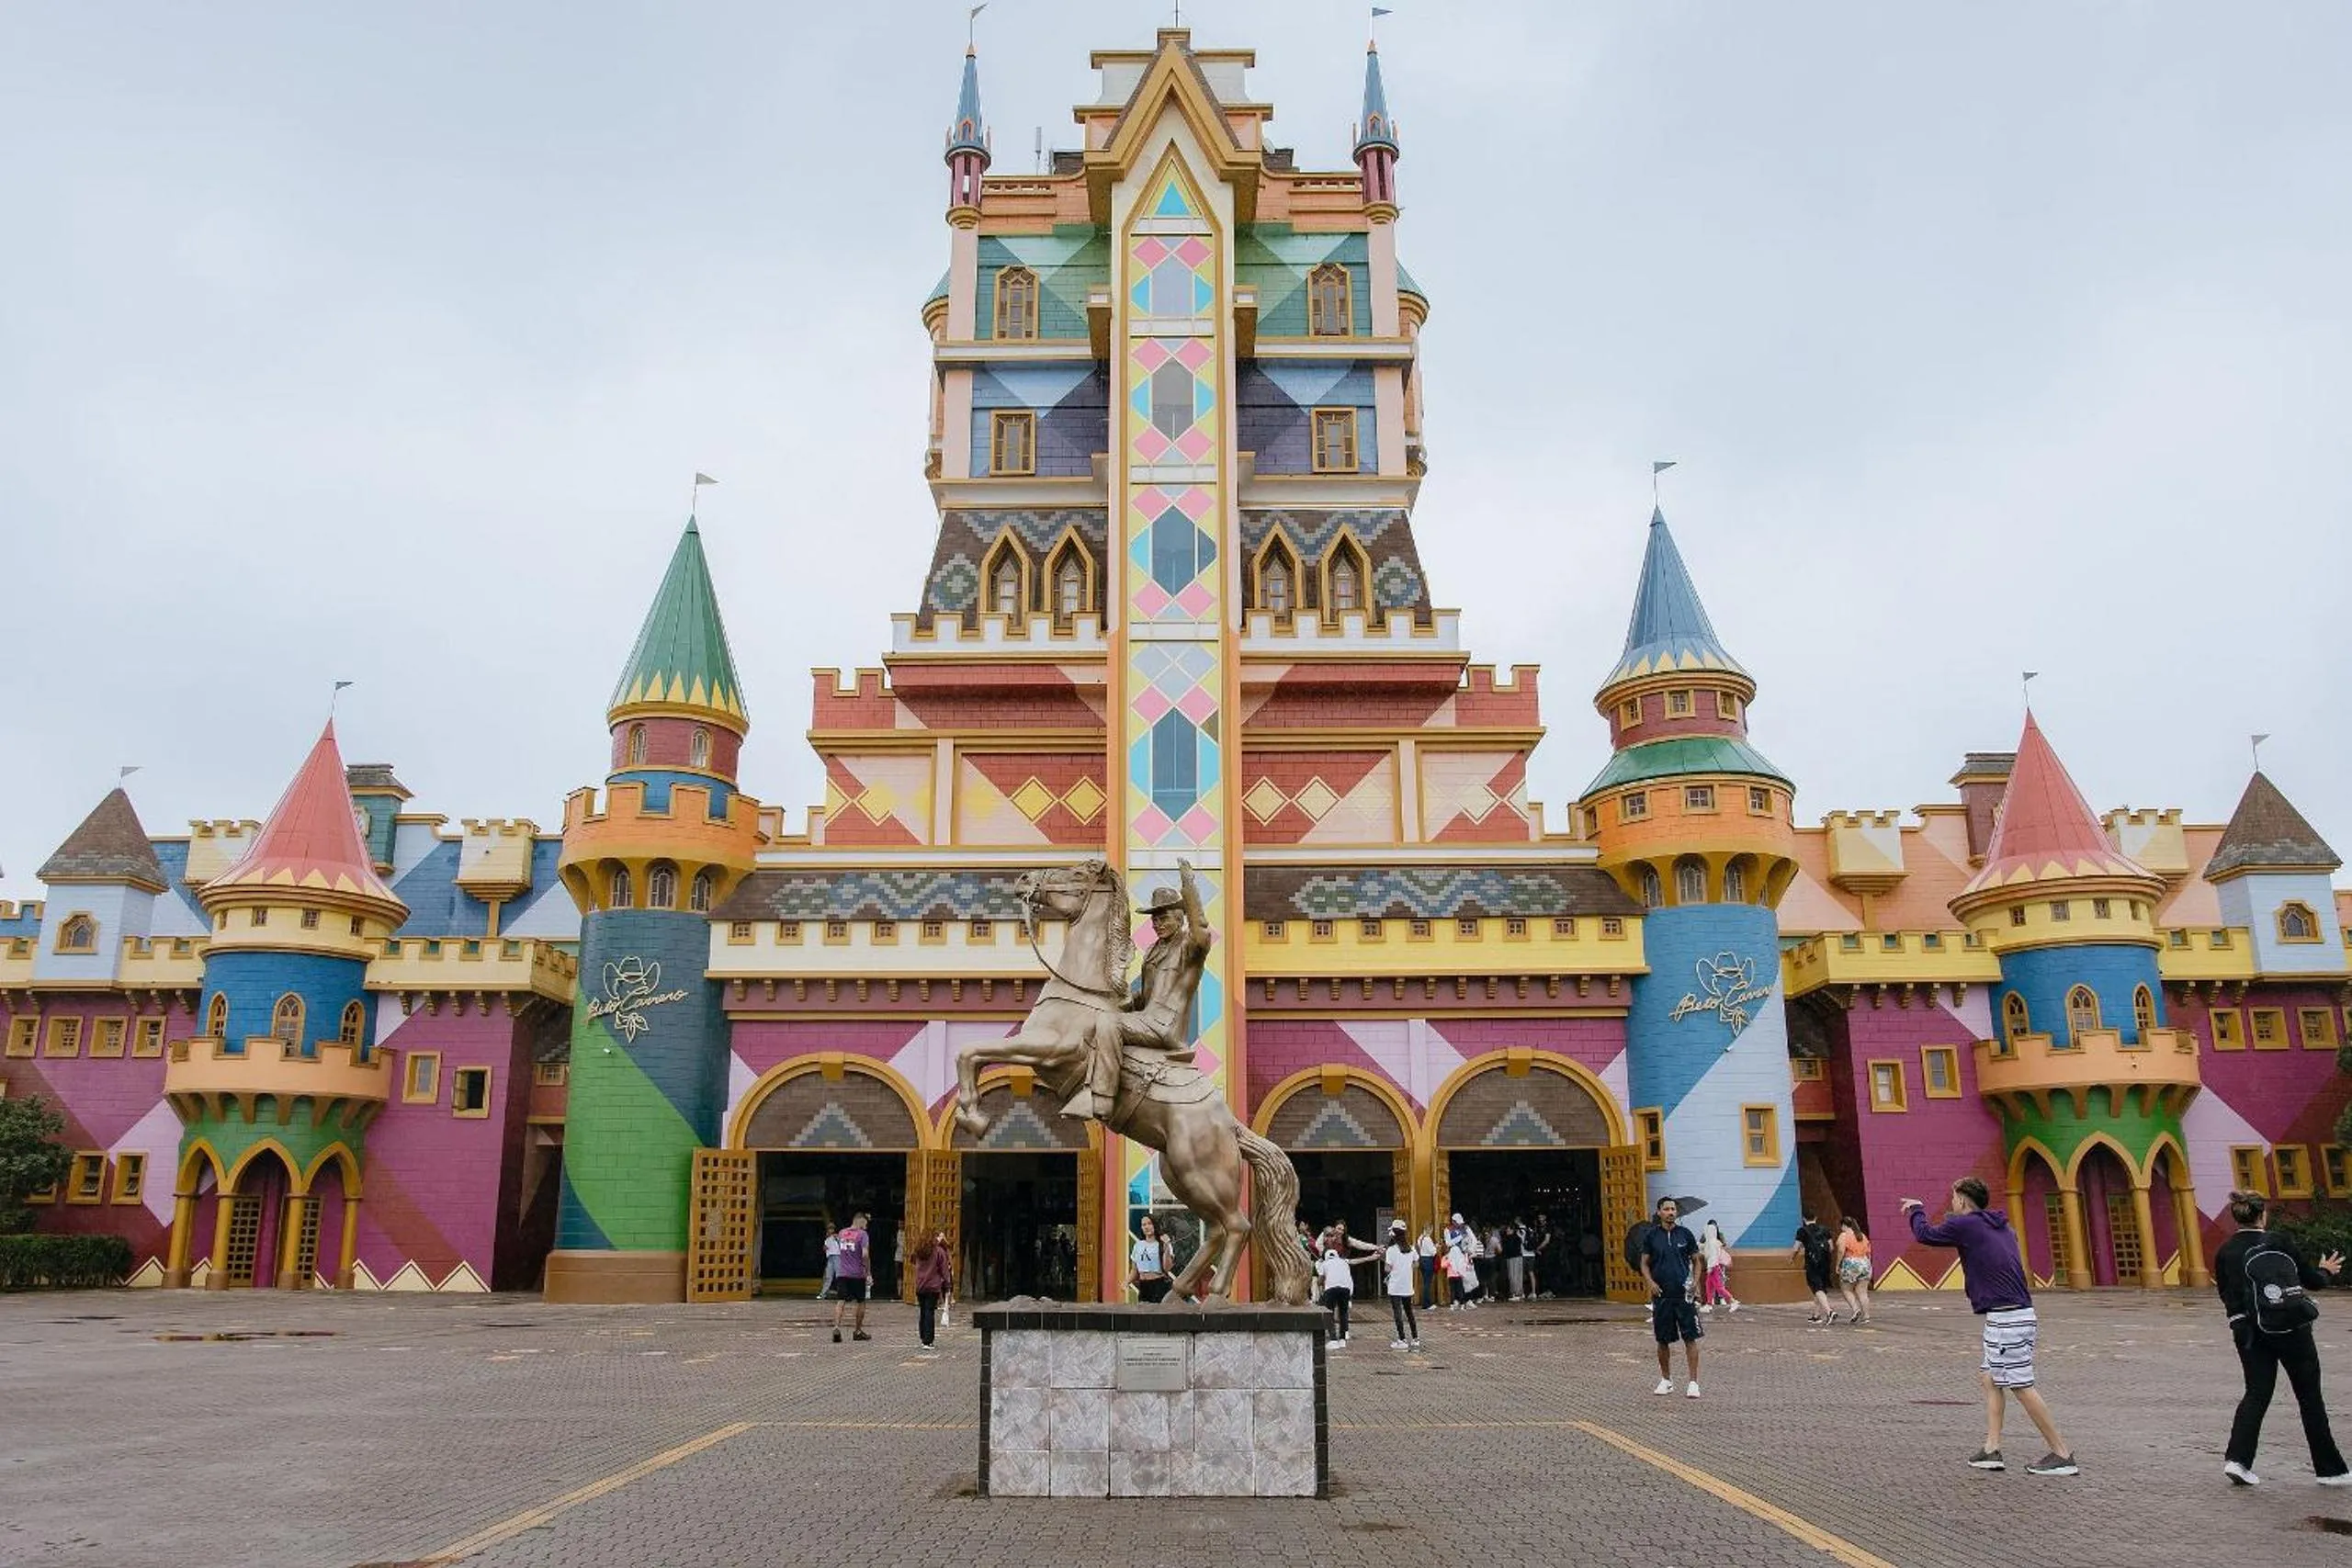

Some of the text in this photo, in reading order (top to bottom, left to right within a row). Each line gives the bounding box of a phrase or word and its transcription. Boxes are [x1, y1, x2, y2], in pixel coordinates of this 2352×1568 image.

[620, 986, 689, 1010] Carrero
[1668, 980, 1777, 1021] Beto Carrer
